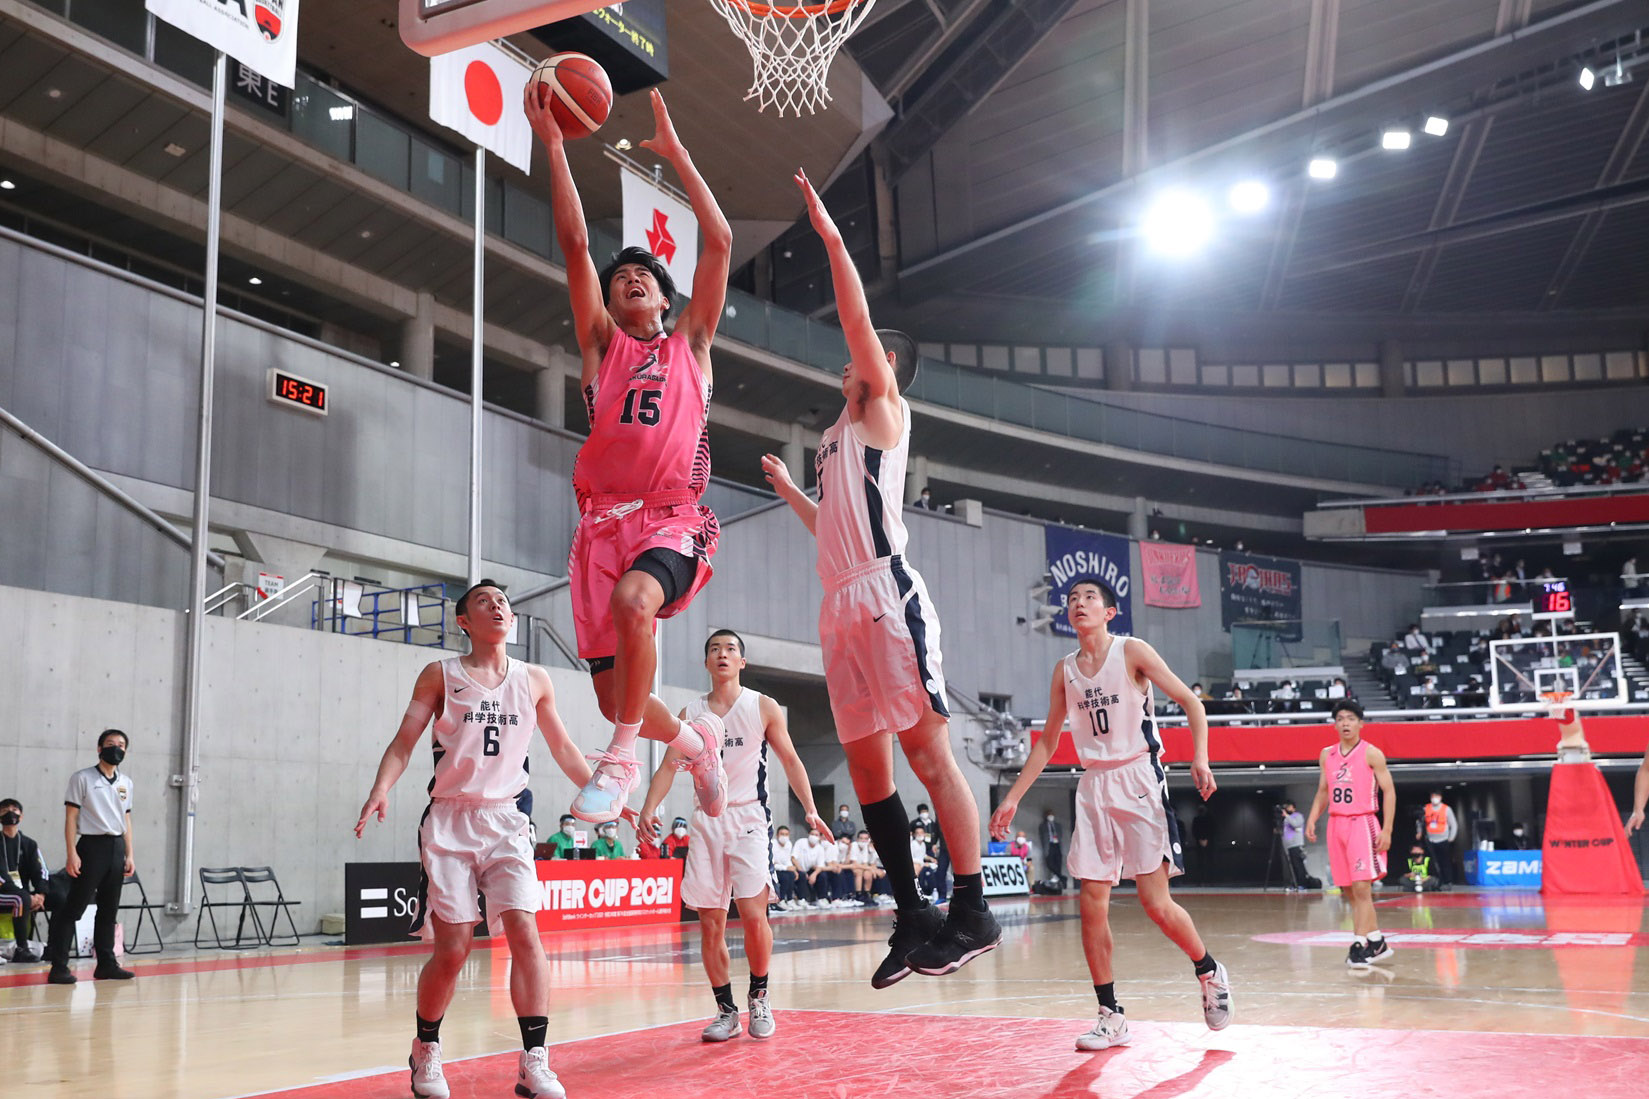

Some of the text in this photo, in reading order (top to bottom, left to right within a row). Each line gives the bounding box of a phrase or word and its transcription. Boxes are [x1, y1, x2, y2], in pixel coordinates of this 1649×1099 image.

[281, 379, 325, 407] 15:21
[619, 388, 663, 427] 15
[1050, 551, 1129, 598] NOSHIRO
[1077, 694, 1119, 710] 科学技術高
[1085, 687, 1103, 698] 能代
[480, 700, 500, 712] 能代
[463, 712, 518, 726] 科学技術高
[1089, 708, 1109, 736] 10
[484, 726, 500, 756] 6
[1333, 788, 1353, 804] 86
[1591, 838, 1614, 847] CUP
[982, 864, 1024, 887] ENEOS
[588, 878, 630, 909] CUP
[630, 876, 674, 906] 2021
